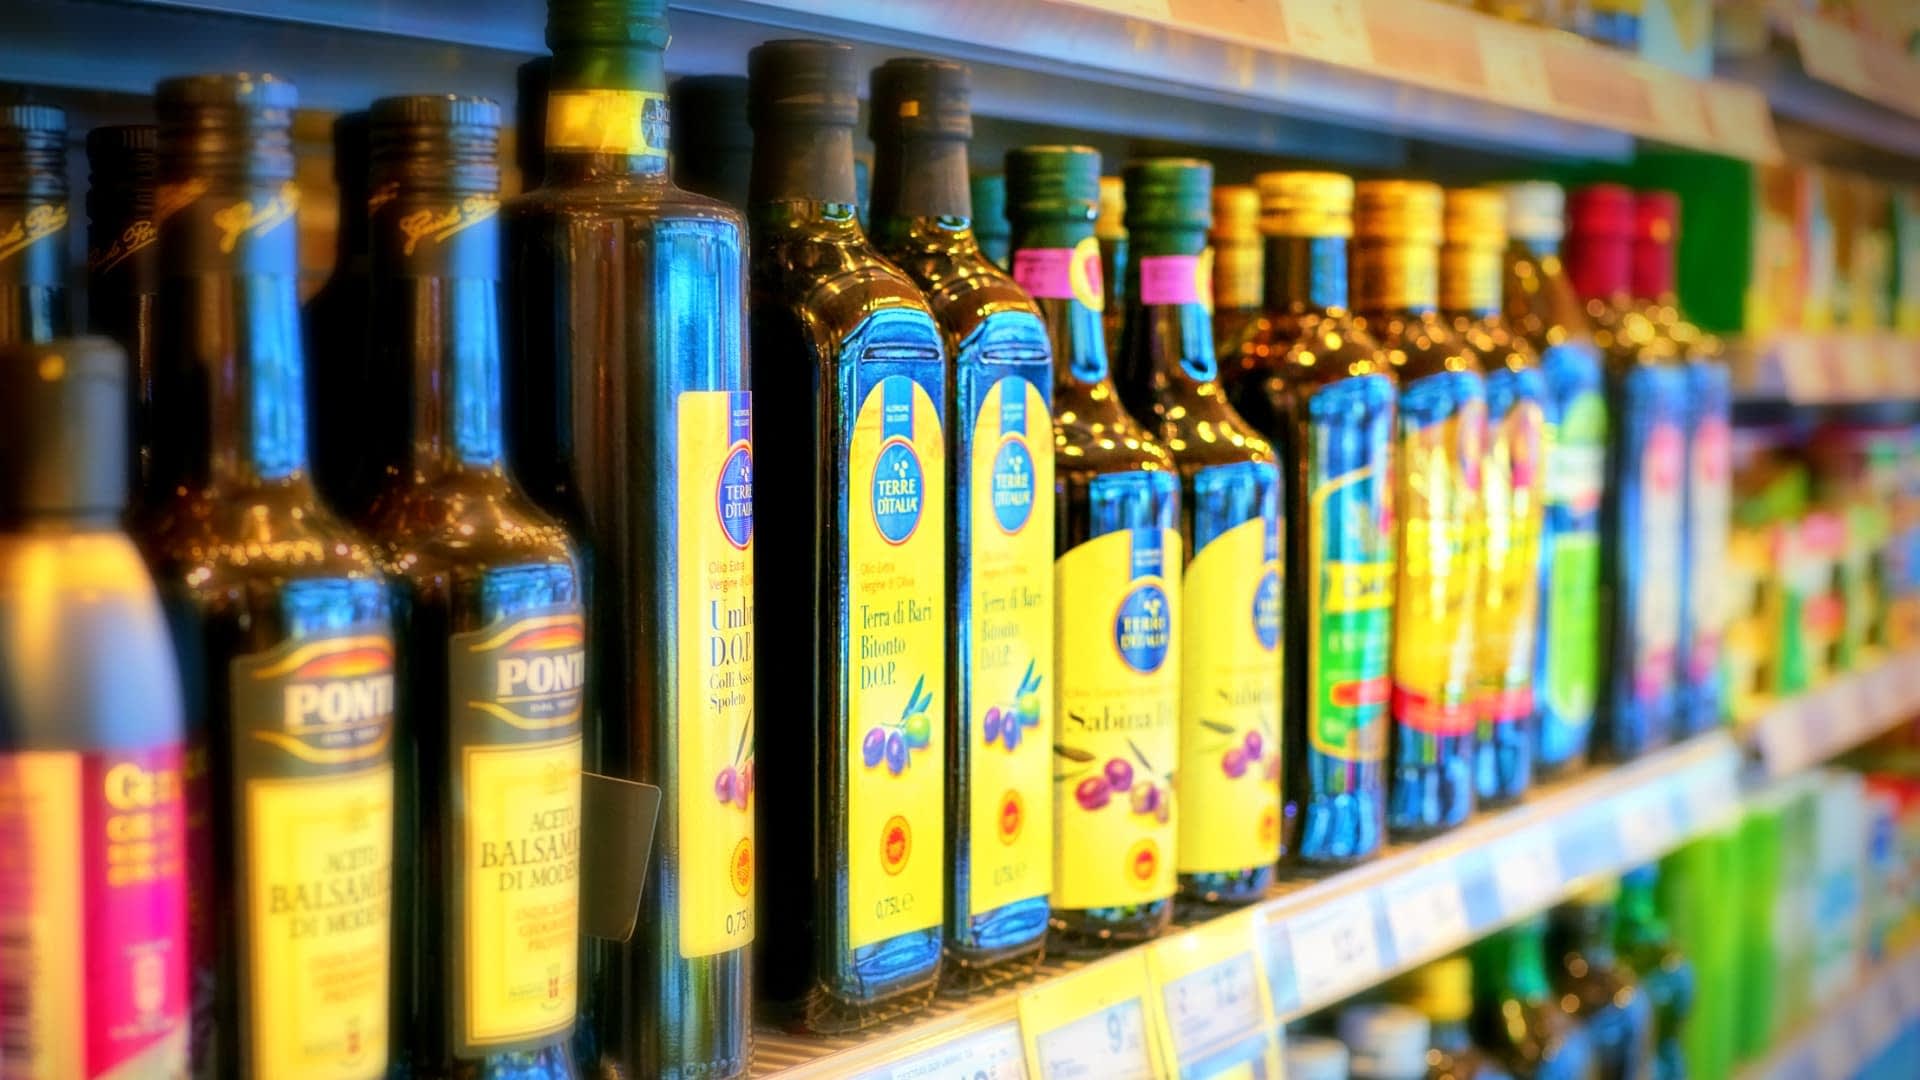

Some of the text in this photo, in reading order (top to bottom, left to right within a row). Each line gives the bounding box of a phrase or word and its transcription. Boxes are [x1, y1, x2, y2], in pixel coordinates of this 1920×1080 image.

[877, 479, 916, 496] TERRE
[860, 597, 932, 629] Terra di Bari
[861, 634, 906, 660] Bitonto
[861, 661, 896, 690] D.O.P.
[710, 690, 746, 714] Spoleto
[529, 806, 574, 833] ACETO
[498, 871, 524, 892] DI
